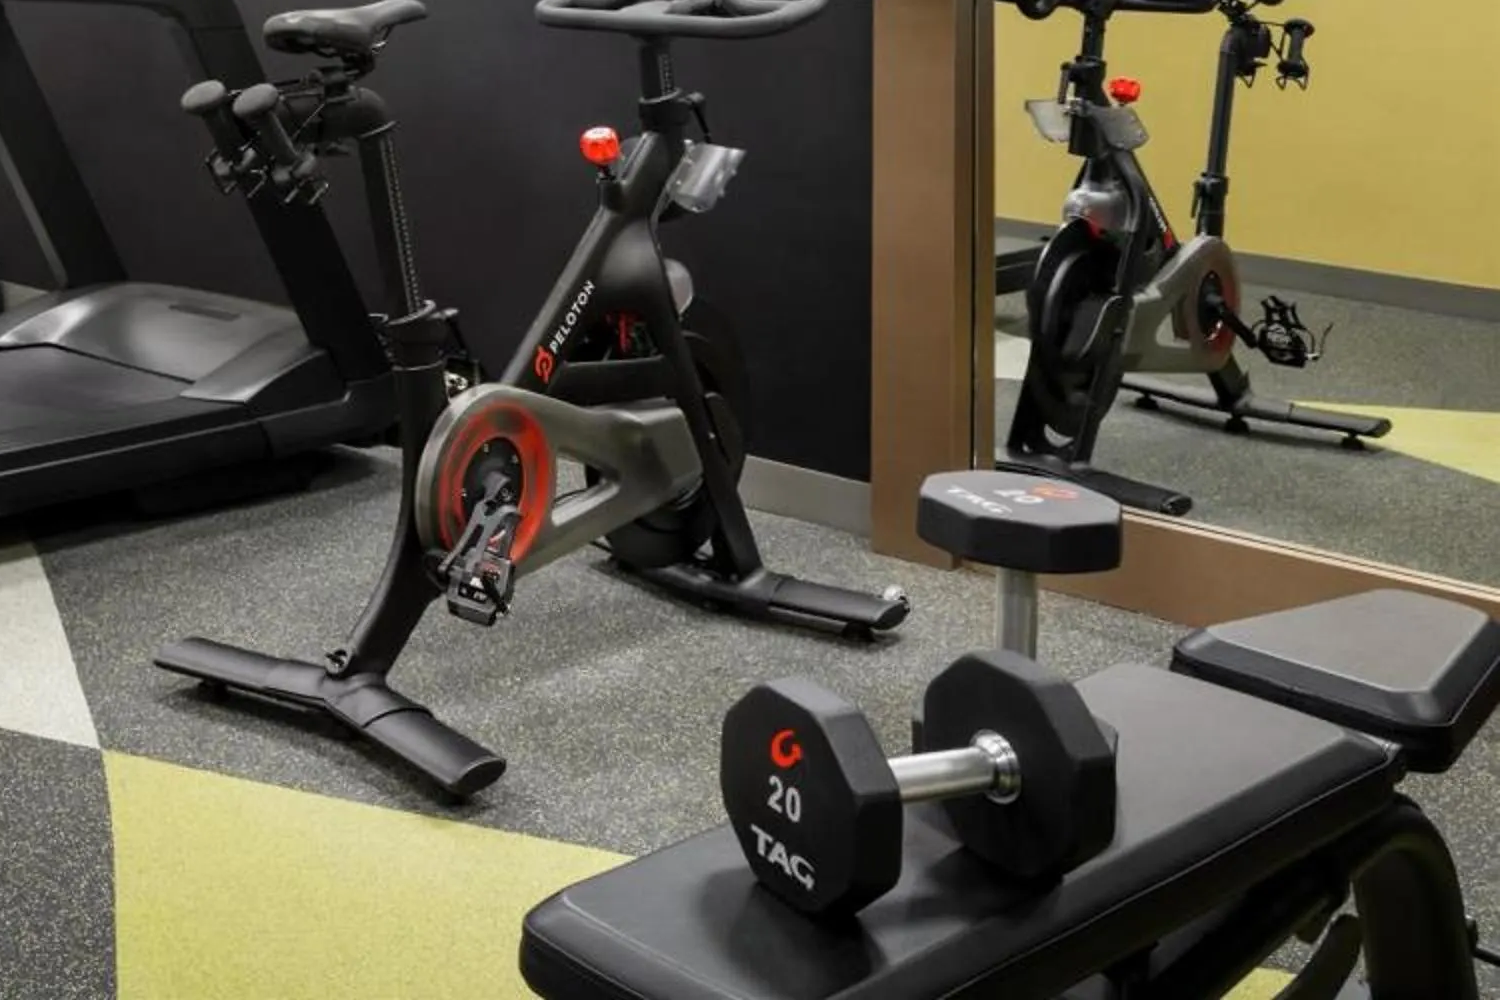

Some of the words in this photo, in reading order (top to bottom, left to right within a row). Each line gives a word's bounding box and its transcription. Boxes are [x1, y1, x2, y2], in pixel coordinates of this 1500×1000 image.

[549, 279, 596, 355] PELOTON
[767, 774, 801, 823] 20
[750, 823, 815, 891] TAG
